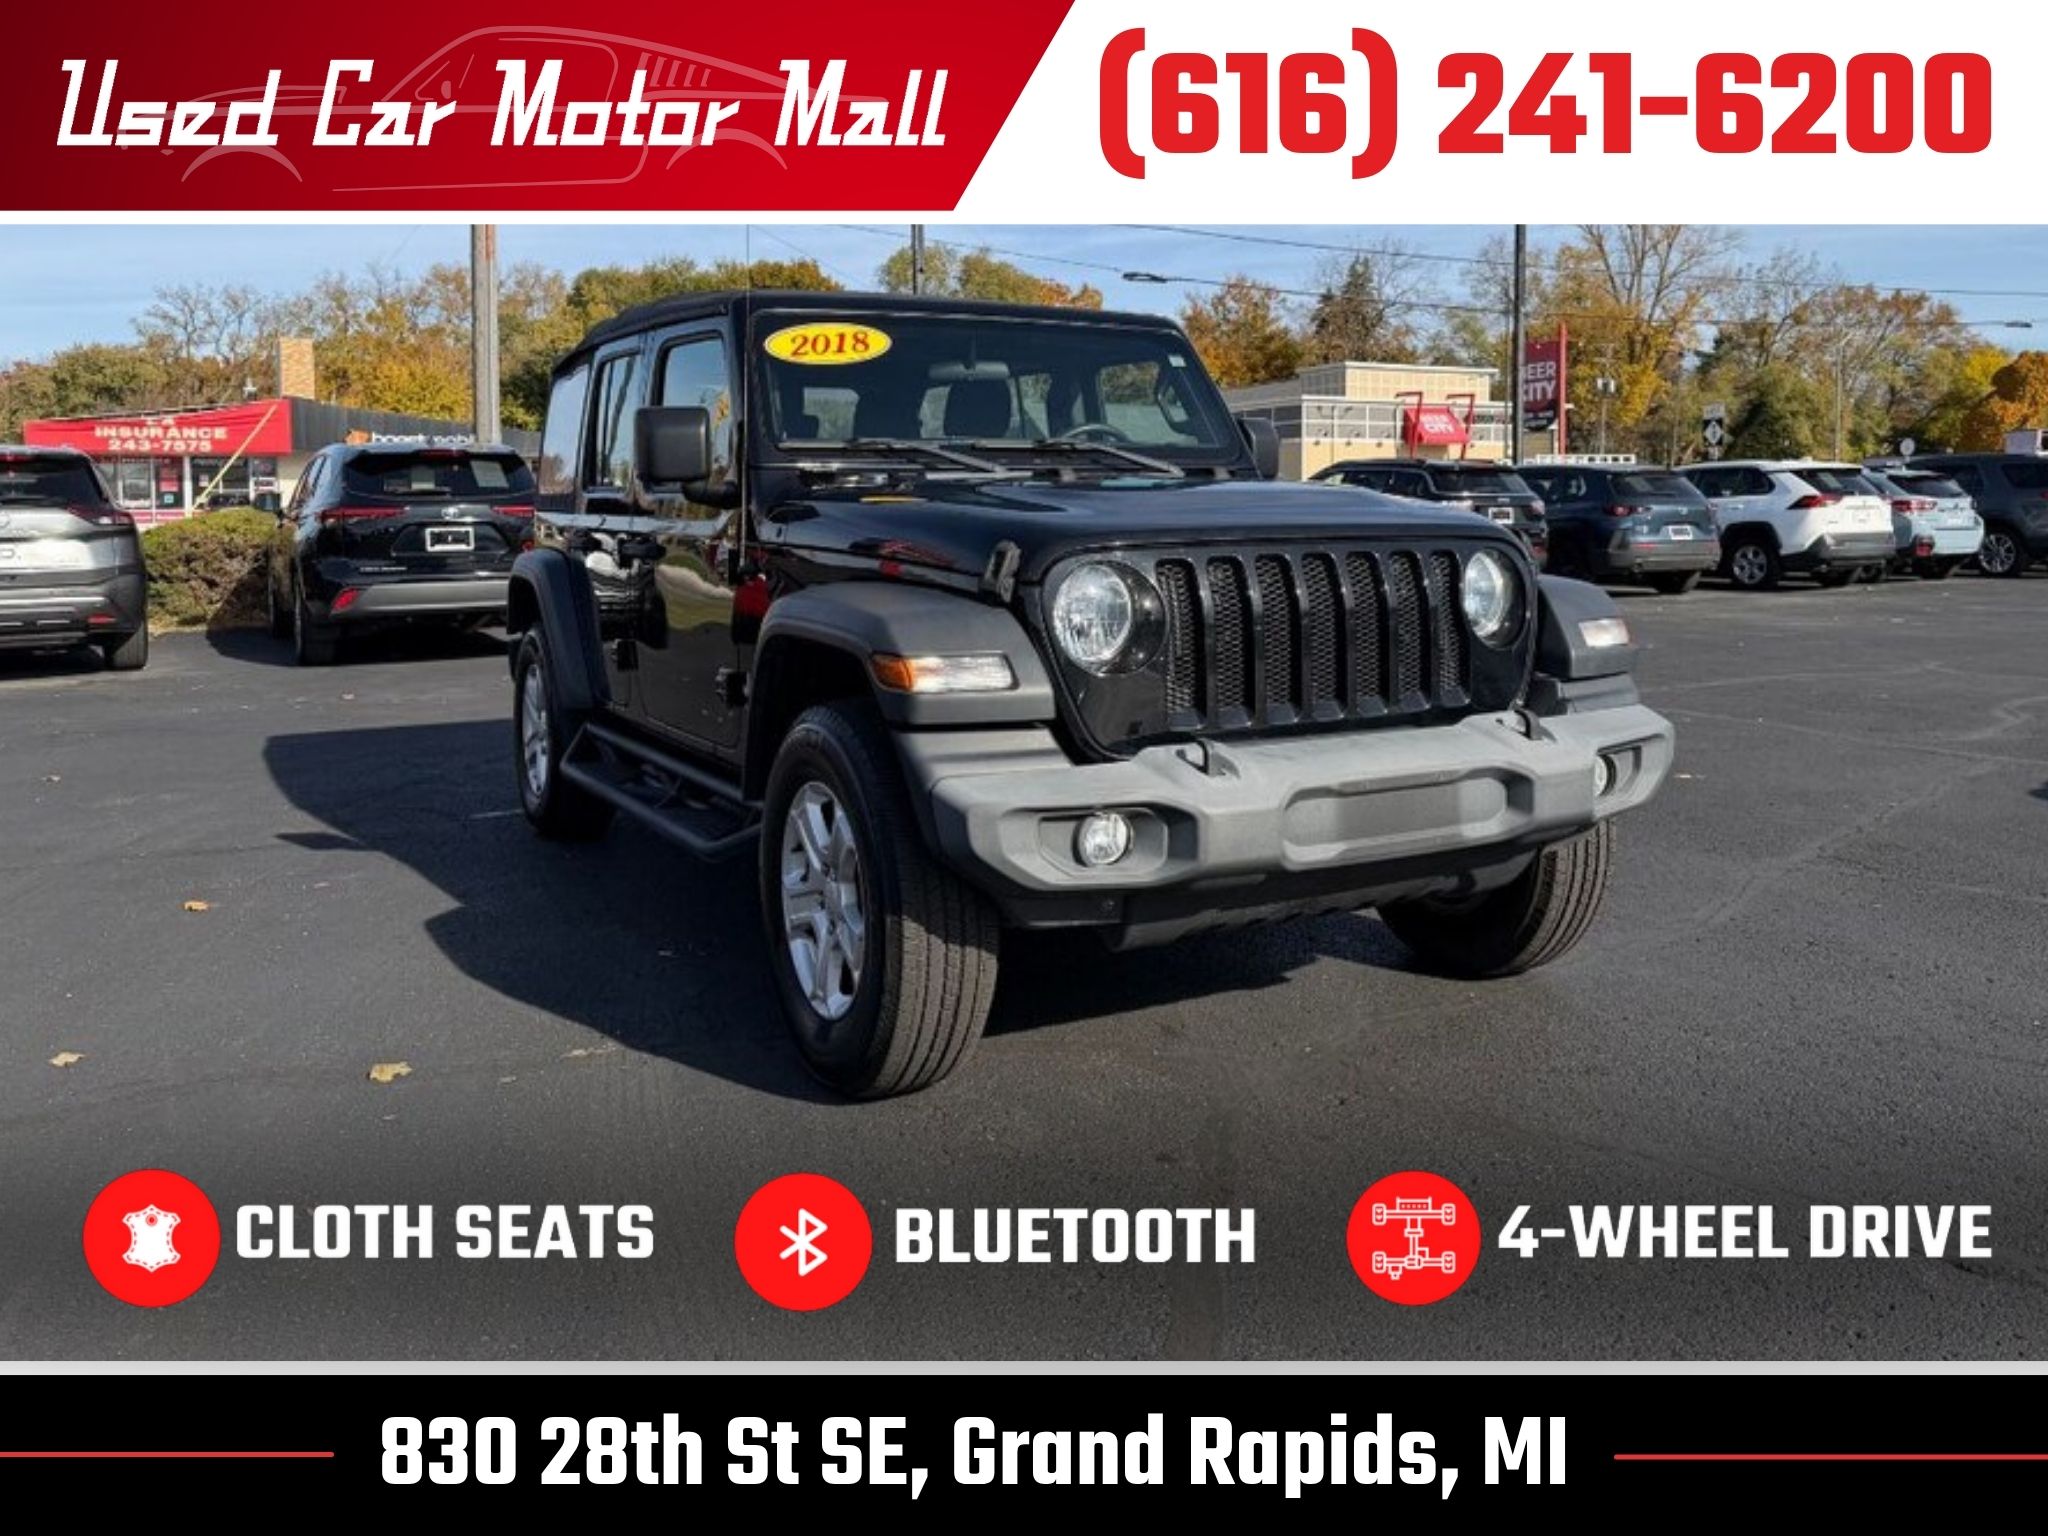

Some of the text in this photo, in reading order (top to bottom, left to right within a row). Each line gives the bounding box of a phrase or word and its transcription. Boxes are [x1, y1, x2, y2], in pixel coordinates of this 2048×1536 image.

[790, 329, 870, 358] 2018
[1524, 361, 1557, 379] EER
[94, 426, 228, 440] INSURANCE
[107, 440, 212, 452] 243-7575
